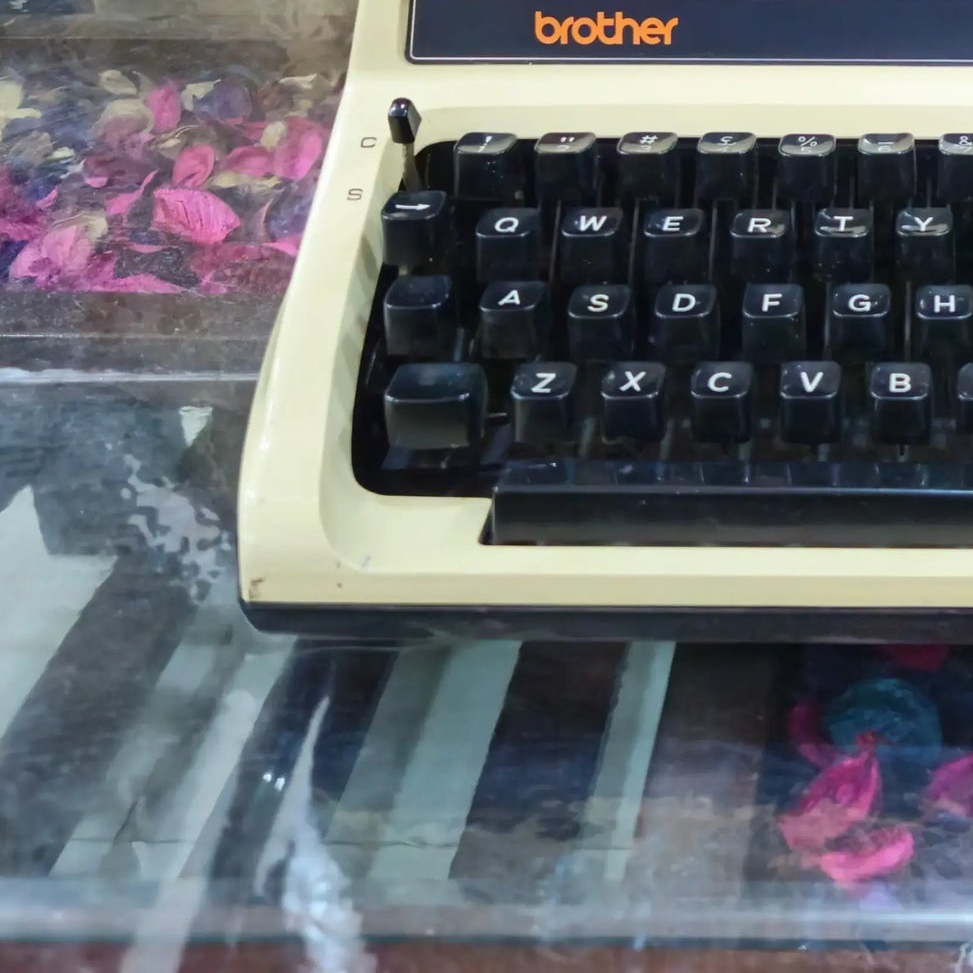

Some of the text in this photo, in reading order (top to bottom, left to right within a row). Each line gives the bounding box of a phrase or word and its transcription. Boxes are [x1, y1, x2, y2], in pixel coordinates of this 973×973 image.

[535, 11, 679, 45] brother
[360, 136, 377, 148] C
[639, 135, 658, 145] #
[798, 136, 817, 147] %
[959, 135, 973, 146] &
[347, 188, 364, 201] S
[494, 217, 519, 233] Q
[578, 215, 608, 231] W
[661, 215, 684, 232] E
[748, 217, 771, 233] R
[833, 215, 854, 232] T
[914, 216, 934, 232] Y
[497, 289, 521, 306] A
[587, 293, 610, 312] S
[672, 293, 696, 312] D
[761, 293, 783, 312] F
[847, 294, 871, 312] G
[933, 294, 956, 313] H
[531, 372, 557, 393] Z
[619, 371, 646, 392] X
[707, 372, 732, 392] C
[800, 371, 824, 393] V
[888, 373, 912, 393] B
